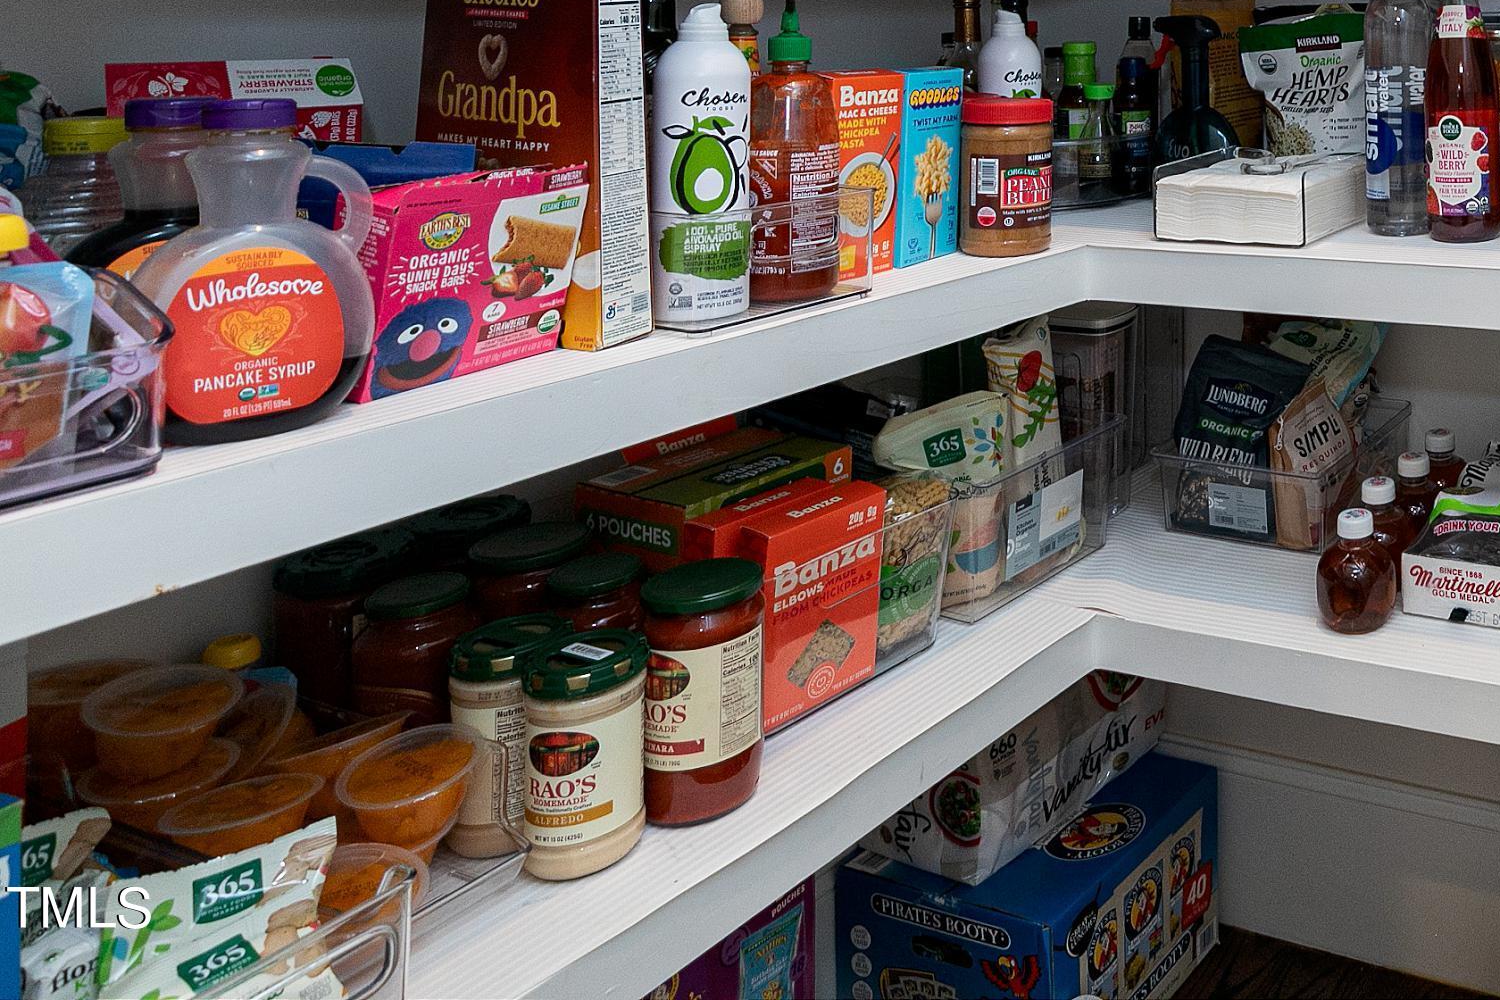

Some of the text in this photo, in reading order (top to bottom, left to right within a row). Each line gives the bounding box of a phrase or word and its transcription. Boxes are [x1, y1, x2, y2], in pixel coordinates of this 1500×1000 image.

[1441, 23, 1463, 33] ITALY
[1297, 34, 1341, 48] KIRKLAND
[1300, 54, 1342, 69] Organic
[239, 79, 313, 88] STRAWBERRY
[1004, 69, 1042, 85] Chosen
[1290, 66, 1348, 89] HEMP
[437, 71, 560, 139] Grandpa
[681, 87, 747, 106] Chosen
[840, 85, 898, 107] Banza
[909, 87, 960, 106] GOODLES
[1272, 82, 1350, 107] HEARTS
[869, 105, 898, 116] CHEESE
[1365, 66, 1378, 162] smart
[839, 116, 886, 129] MADE WITH
[437, 132, 550, 152] MAKES HEART HAPPY
[1438, 160, 1467, 170] BERRY
[1440, 150, 1463, 160] WILD
[225, 250, 283, 265] SUSTAINABLY
[398, 268, 439, 285] SUNNY
[187, 272, 324, 312] Wholesome
[488, 316, 530, 334] STRAWBERRY
[234, 357, 279, 371] ORGANIC
[193, 360, 316, 393] PANCAKE SYRUP
[1206, 384, 1268, 415] LUNDBERG
[1201, 418, 1250, 438] ORGANIC
[1293, 414, 1342, 458] SIMPLi
[656, 432, 705, 455] Banza
[929, 434, 960, 459] 365
[734, 488, 790, 512] Banza
[786, 494, 843, 519] Banza
[599, 518, 672, 549] POUCHES
[1468, 521, 1498, 532] YOUR
[772, 534, 876, 601] Banza
[773, 583, 825, 612] ELBOWS
[1432, 589, 1456, 600] GOLD
[989, 732, 1017, 760] 660
[529, 774, 597, 799] RAO'S
[533, 795, 586, 808] HOMEMADE
[534, 812, 585, 825] ALFREDO
[201, 869, 257, 903] 365
[1186, 873, 1207, 907] 40
[771, 884, 806, 918] POUCHES
[881, 898, 1000, 945] PIRATE'S BOOTY
[188, 943, 249, 985] 365
[1149, 936, 1189, 990] BOOTY
